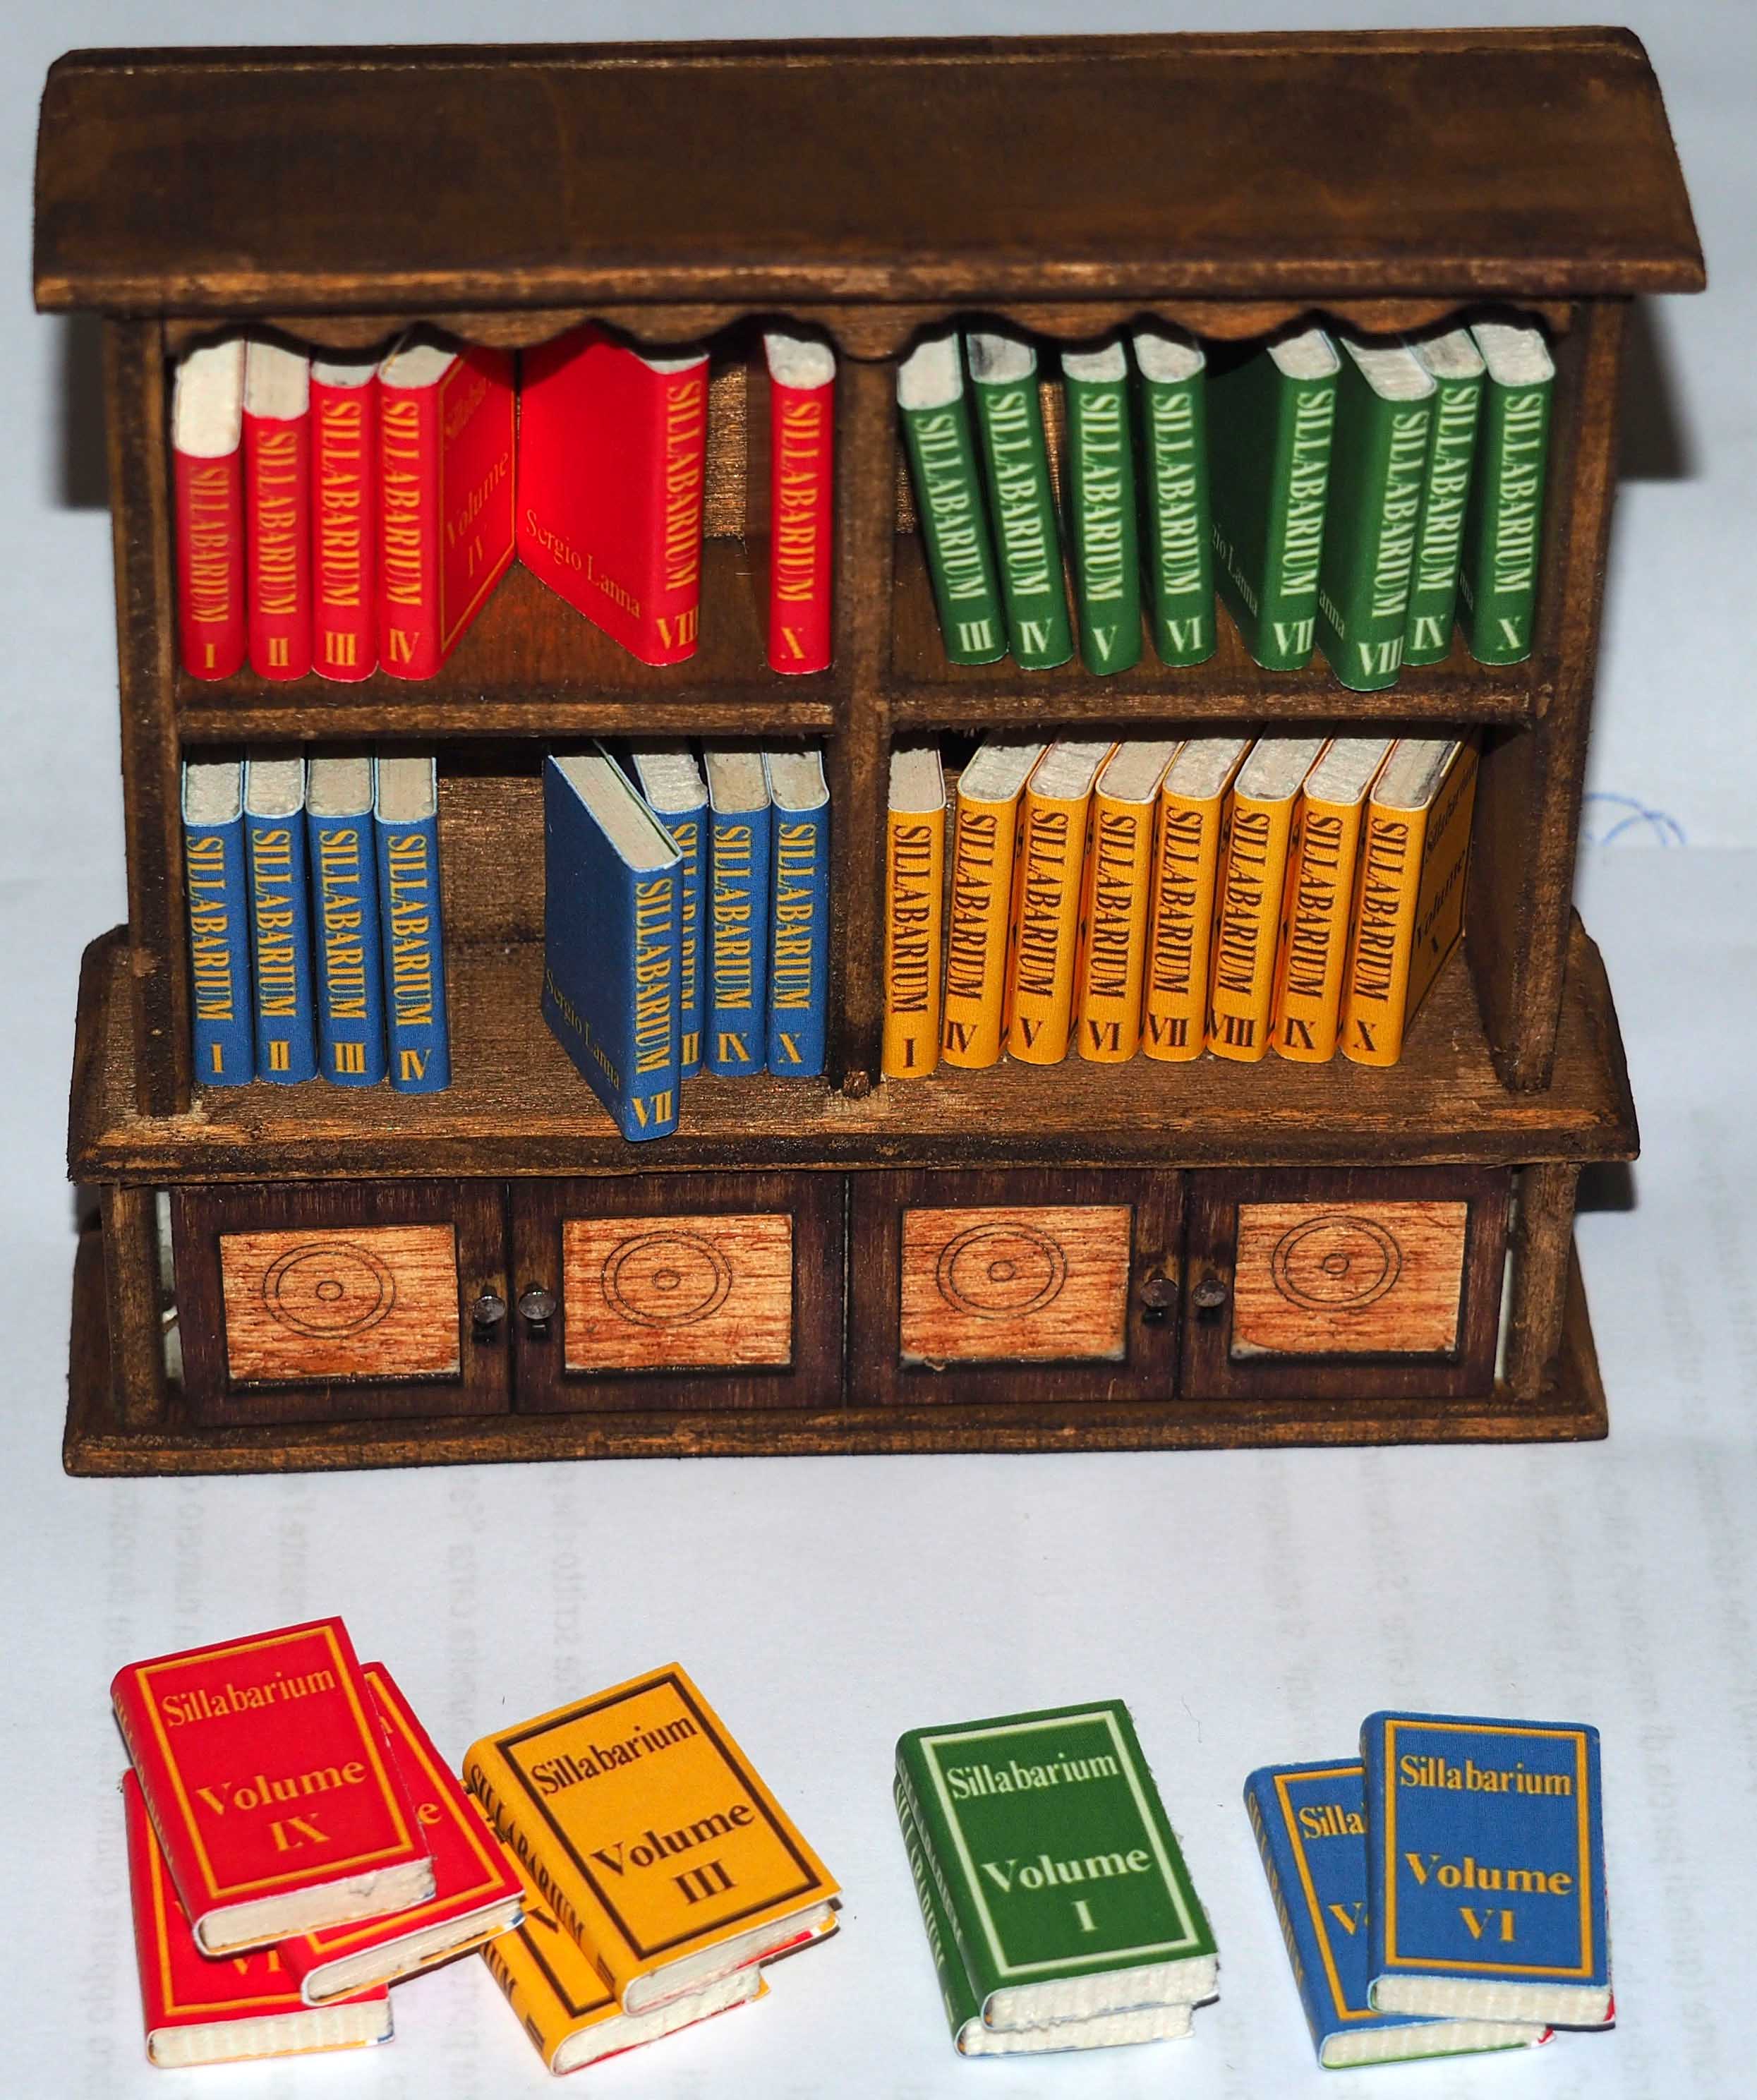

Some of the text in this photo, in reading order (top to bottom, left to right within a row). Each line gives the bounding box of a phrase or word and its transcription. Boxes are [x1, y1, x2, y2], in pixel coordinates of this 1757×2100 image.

[322, 399, 361, 605] SILLABARIUM
[384, 397, 421, 605] SILLABARIUM
[666, 380, 701, 591] SILLABARIUM
[777, 400, 821, 602] SILLABARIUM
[914, 414, 987, 601] SILLABARIUM
[987, 391, 1051, 596] SILLABARIUM
[1080, 392, 1123, 601] SILLABARIUM
[1152, 392, 1202, 595] SILLABARIUM
[1280, 389, 1336, 597] SILLABARIUM
[1416, 385, 1479, 592] SILLABARIUM
[1494, 392, 1543, 593] SILLABARIUM
[258, 430, 296, 614] SILLABARIUM
[1371, 410, 1430, 617] SILLABARIUM
[190, 467, 229, 622] SILLABARIUM
[526, 509, 641, 619] Sergio Lanna
[205, 644, 215, 668] I
[268, 637, 289, 666] II
[326, 632, 356, 665] III
[390, 629, 420, 663] IV
[780, 627, 805, 659] X
[956, 619, 995, 652] III
[1018, 617, 1052, 654] IV
[1093, 624, 1117, 661] V
[1166, 615, 1202, 652] VI
[1274, 617, 1315, 656] VII
[1411, 614, 1446, 651] IX
[1497, 615, 1522, 651] X
[1358, 636, 1404, 677] VIII
[252, 828, 297, 1018] SILLABARIUM
[318, 828, 368, 1019] SILLABARIUM
[713, 824, 753, 1010] SILLABARIUM
[773, 823, 817, 1010] SILLABARIUM
[892, 824, 932, 1013] SILLABARIUM
[948, 809, 998, 1001] SILLABARIUM
[1018, 808, 1070, 999] SILLABARIUM
[1089, 810, 1137, 999] SILLABARIUM
[1154, 807, 1204, 995] SILLABARIUM
[1218, 806, 1270, 996] SILLABARIUM
[1287, 811, 1344, 1000] SILLABARIUM
[1353, 818, 1409, 1001] SILLABARIUM
[186, 835, 235, 1021] SILLABARIUM
[387, 835, 433, 1026] SILLABARIUM
[634, 876, 673, 1073] SILLABARIUM
[718, 1032, 751, 1063] IX
[778, 1032, 803, 1063] X
[946, 1020, 977, 1054] IV
[1020, 1018, 1044, 1049] V
[1087, 1020, 1122, 1051] VI
[1147, 1011, 1190, 1047] VII
[1209, 1009, 1256, 1047] VIII
[1283, 1018, 1316, 1050] IX
[1353, 1020, 1377, 1051] X
[212, 1044, 224, 1073] I
[268, 1040, 290, 1072] II
[334, 1042, 366, 1074] III
[399, 1049, 431, 1081] IV
[903, 1039, 917, 1068] I
[631, 1089, 673, 1129] VII
[162, 1670, 336, 1727] Sillabarium
[531, 1717, 699, 1797] Sillabarium
[946, 1752, 1121, 1801] Sillabarium
[1400, 1754, 1573, 1797] Sillabarium
[195, 1761, 368, 1816] Volume
[268, 1812, 332, 1852] IX
[591, 1804, 756, 1877] Volume
[671, 1859, 738, 1905] III
[982, 1849, 1153, 1893] Volume
[1405, 1852, 1574, 1896] Volume
[1073, 1899, 1098, 1933] I
[1459, 1907, 1516, 1943] VI
